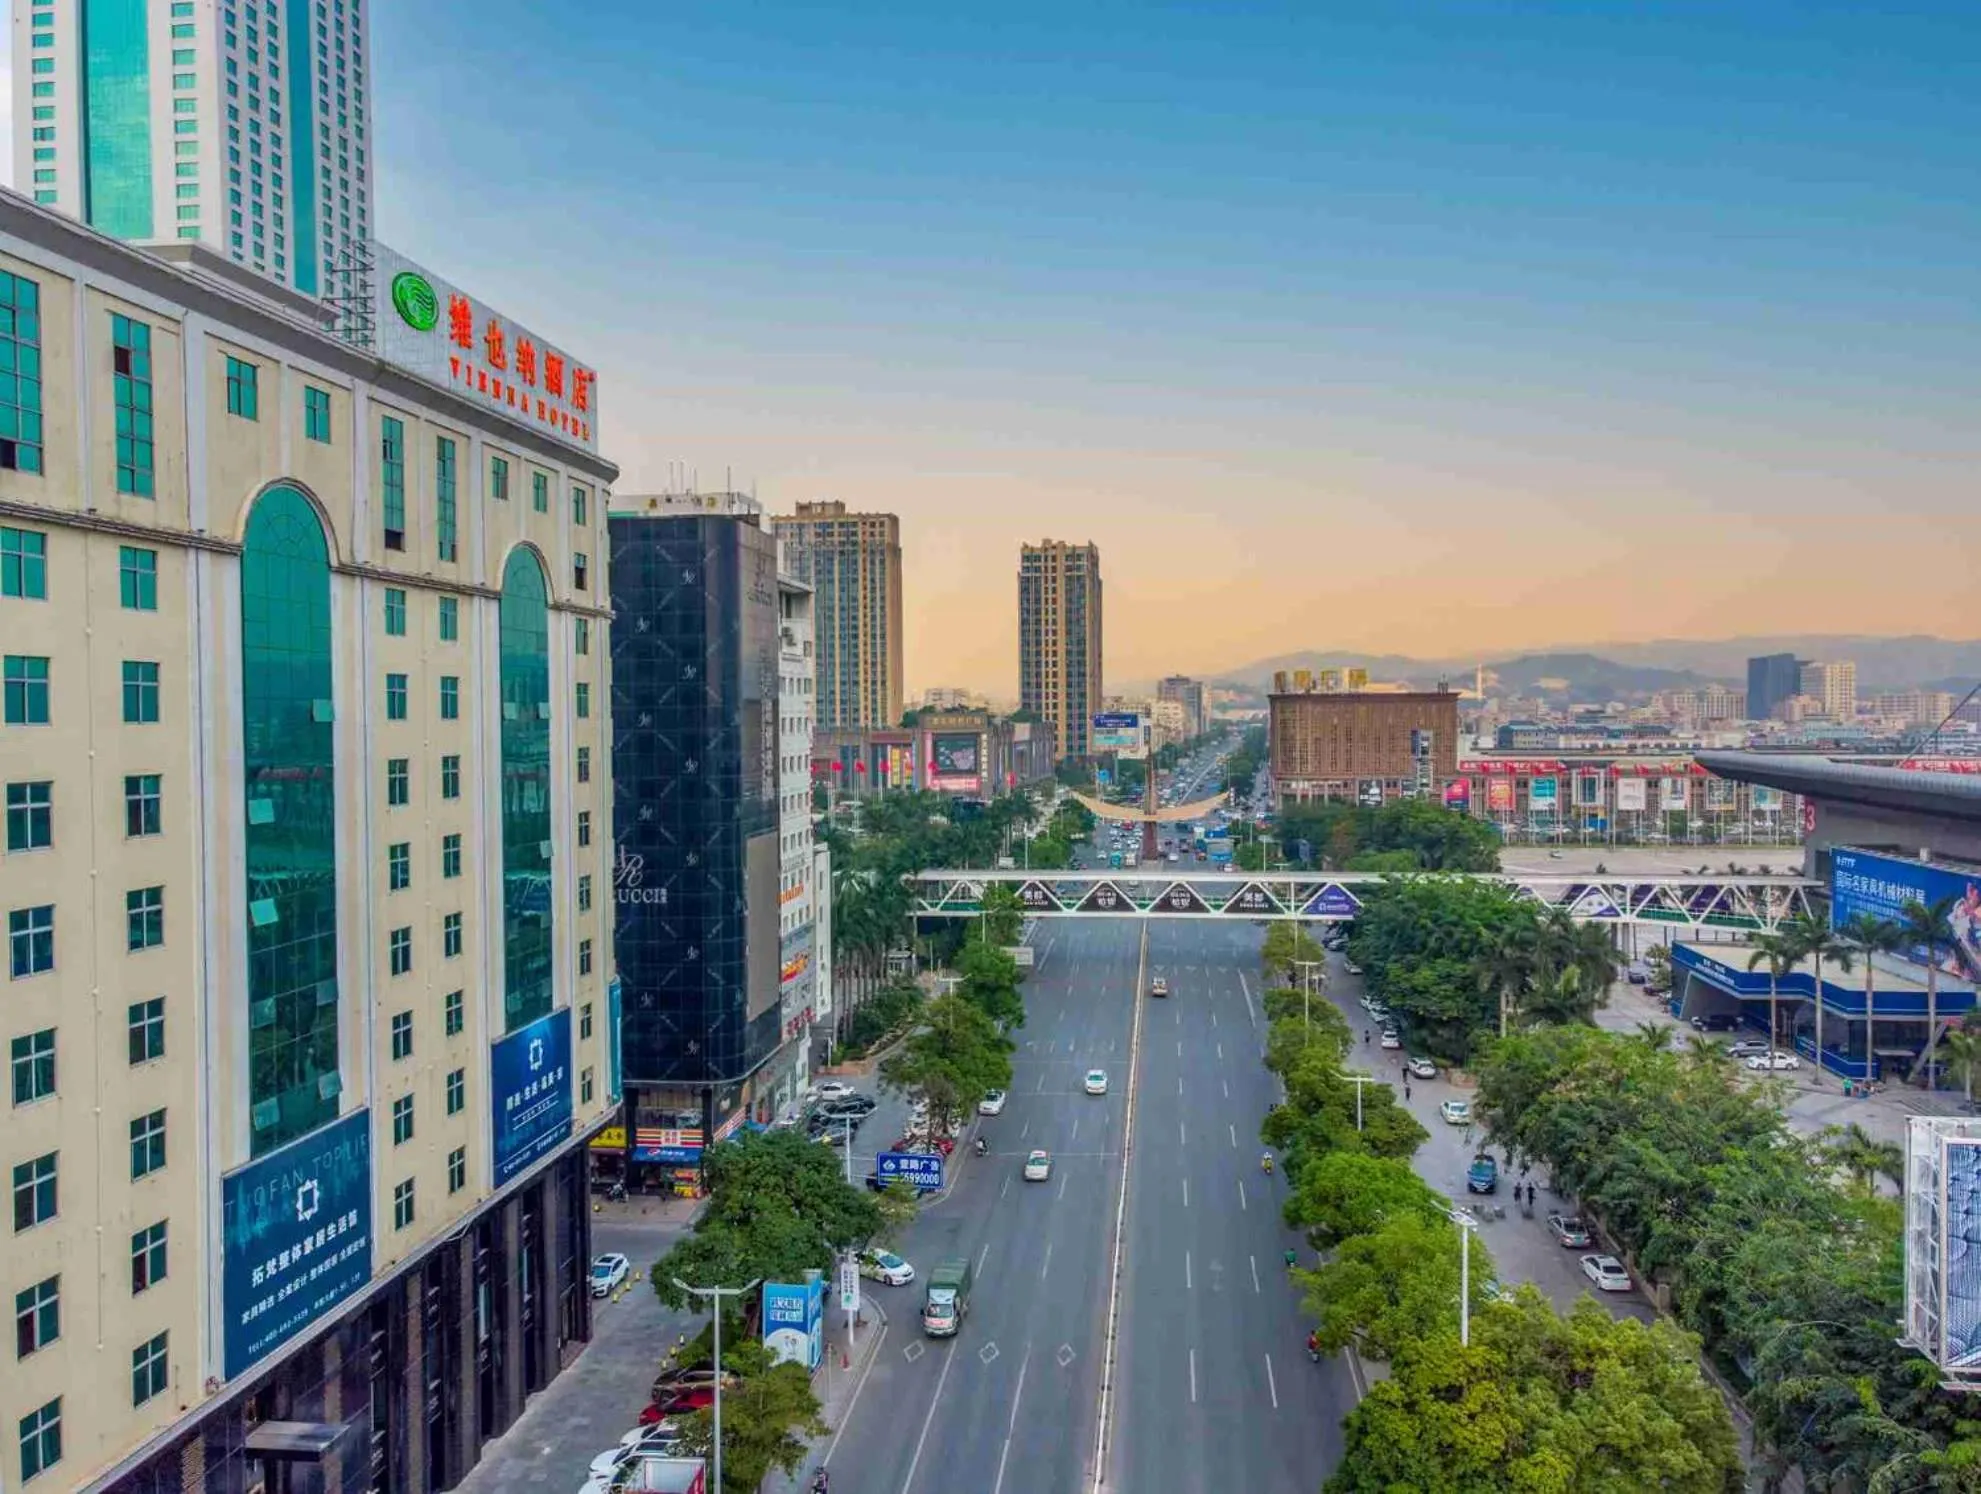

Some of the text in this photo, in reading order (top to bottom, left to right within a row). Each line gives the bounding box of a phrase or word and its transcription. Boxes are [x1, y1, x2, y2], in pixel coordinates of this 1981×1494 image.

[449, 292, 591, 412] 维也纳酒店
[449, 355, 590, 441] VIENNA HOTEL
